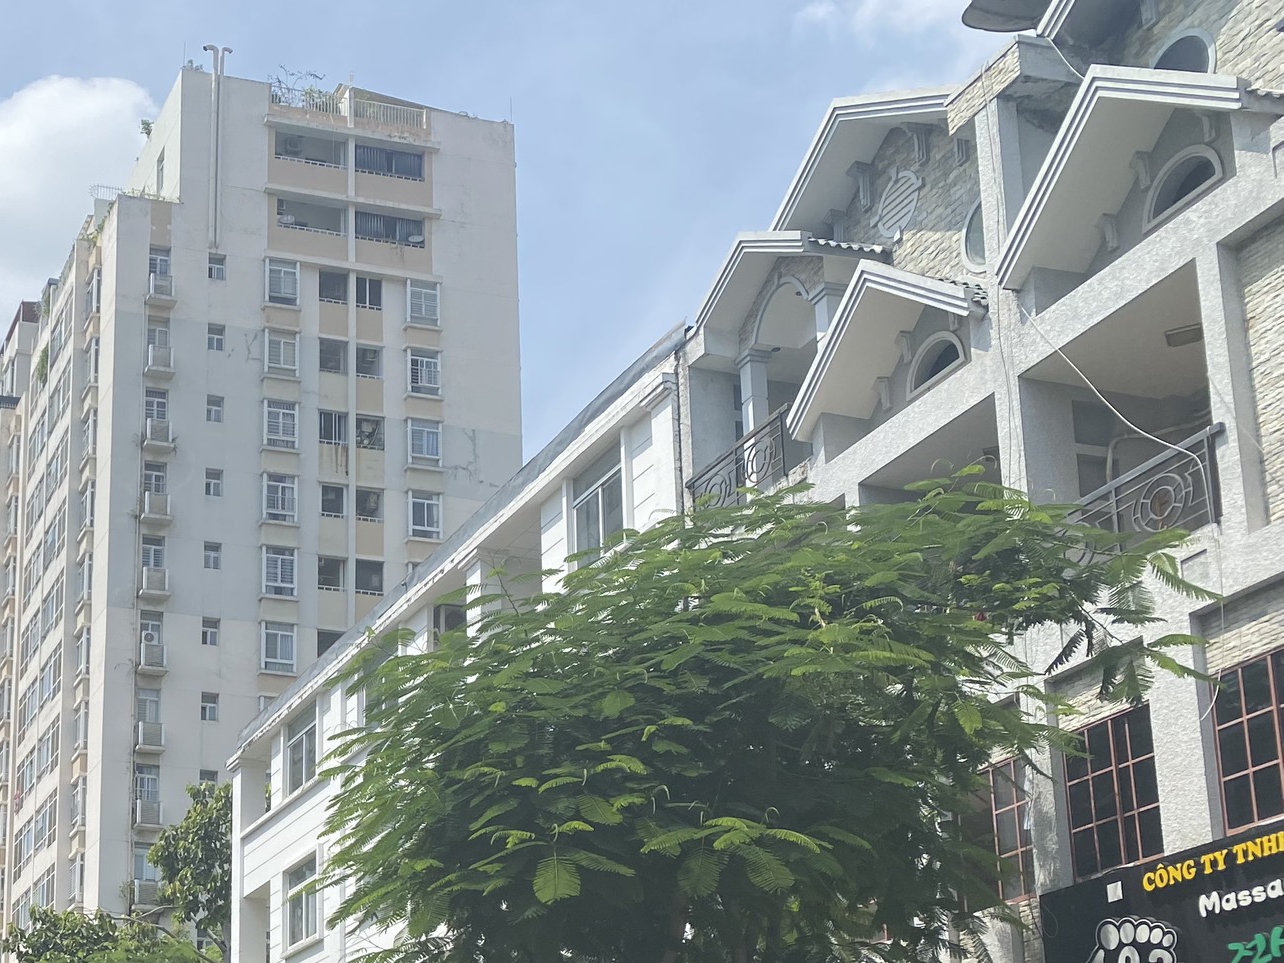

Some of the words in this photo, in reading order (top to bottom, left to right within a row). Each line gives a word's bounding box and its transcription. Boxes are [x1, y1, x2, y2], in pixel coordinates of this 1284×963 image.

[1142, 863, 1197, 892] CÔNG
[1201, 849, 1228, 874] TY
[1199, 879, 1283, 917] Massa
